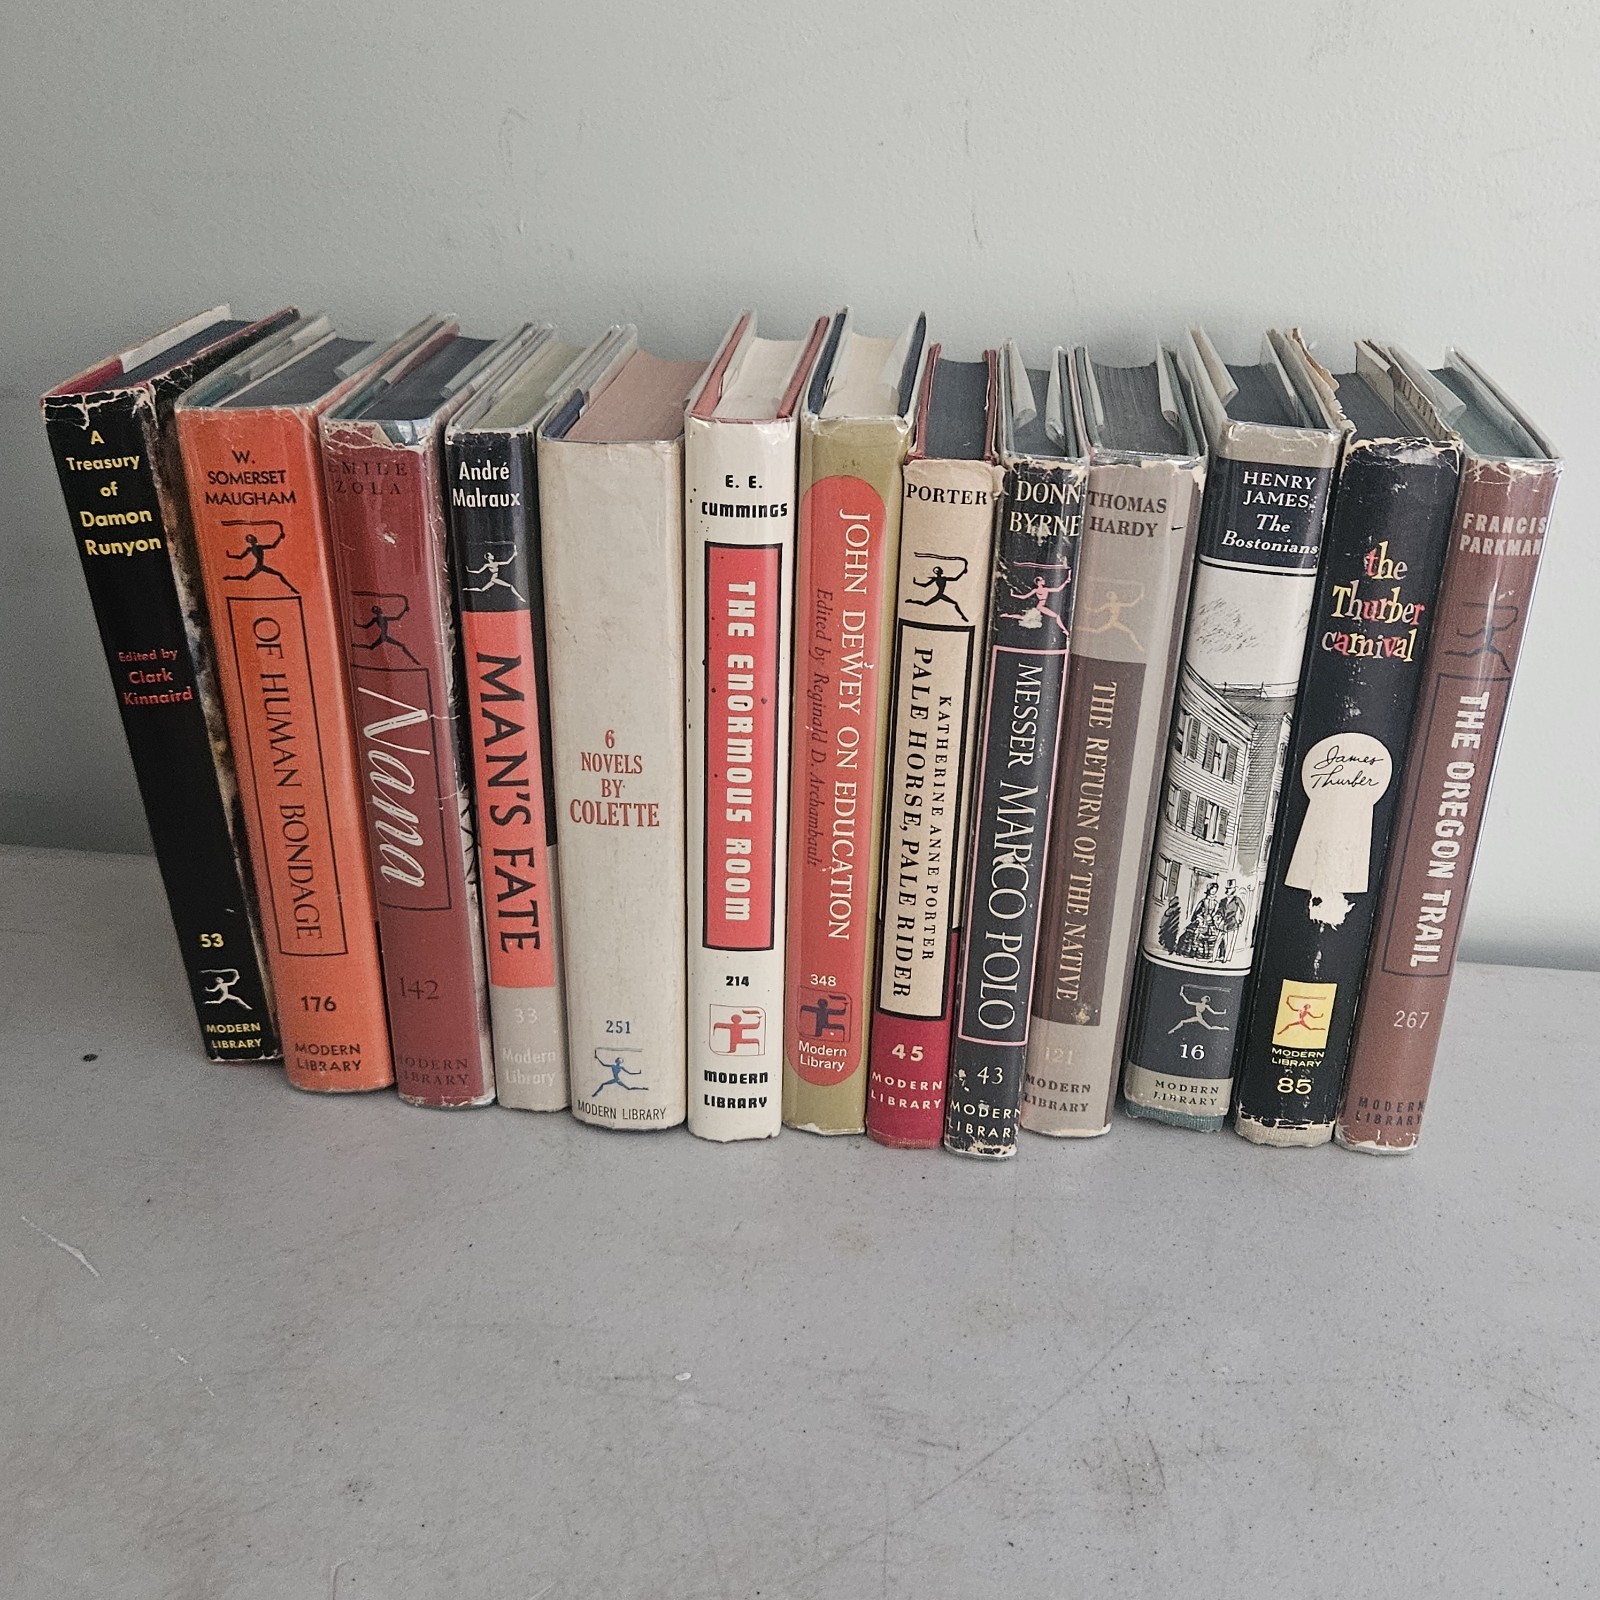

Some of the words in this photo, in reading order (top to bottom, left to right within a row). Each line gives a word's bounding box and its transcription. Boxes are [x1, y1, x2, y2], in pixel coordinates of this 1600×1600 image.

[90, 430, 104, 445] A
[66, 455, 140, 471] Treasury
[232, 450, 255, 464] W.
[207, 470, 286, 485] SOMERSET
[459, 459, 510, 480] André
[100, 481, 118, 497] of
[335, 480, 401, 495] ZOLA
[726, 475, 739, 488] E.
[749, 475, 763, 489] E.
[1243, 471, 1316, 490] HENRY
[205, 491, 296, 505] MAUGHAM
[452, 487, 521, 507] Malraux
[907, 483, 988, 505] PORTER
[1016, 480, 1080, 504] DONN
[1088, 491, 1167, 513] THOMAS
[80, 509, 152, 528] Damon
[702, 502, 788, 518] CUMMINGS
[1010, 511, 1081, 537] BYRNE
[1089, 516, 1158, 538] HARDY
[1256, 514, 1291, 533] The
[1463, 512, 1547, 534] FRANCIS
[84, 537, 161, 557] Runyon
[839, 508, 871, 594] JOHN
[1221, 531, 1319, 555] Bostonians
[1365, 541, 1408, 581] the
[728, 581, 756, 637] THE
[1331, 581, 1425, 626] Thurber
[815, 589, 833, 641] Edited
[253, 617, 284, 659] OF
[1321, 628, 1417, 662] carnival
[118, 650, 157, 662] Edited
[161, 649, 178, 661] by
[809, 649, 831, 665] by
[839, 610, 866, 715] DEWEY
[129, 668, 173, 684] Clark
[909, 647, 934, 720] PALE
[124, 687, 193, 705] Kinnaird
[1088, 681, 1118, 730] THE
[807, 671, 829, 744] Reginald
[1008, 662, 1043, 769] MESSER
[260, 672, 302, 788] HUMAN
[1451, 691, 1490, 749] THE
[476, 652, 532, 827] MAN'S
[605, 729, 615, 748] 6
[726, 654, 754, 823] ENORMOUS
[836, 726, 860, 770] ON
[581, 752, 643, 774] NOVELS
[811, 749, 827, 767] D.
[931, 695, 952, 816] KATHERINE
[1314, 745, 1384, 770] James
[357, 686, 430, 888] Nana
[899, 728, 927, 832] HORSE,
[1077, 738, 1110, 831] RETURN
[1310, 766, 1379, 789] Thurber
[601, 778, 623, 798] BY
[570, 799, 660, 827] COLETTE
[807, 771, 825, 867] Archambault
[1426, 760, 1476, 879] OREGON
[926, 824, 948, 879] ANNE
[989, 780, 1039, 920] MARCO
[1072, 835, 1097, 866] OF
[828, 781, 857, 940] EDUCATION
[280, 803, 323, 940] BONDAGE
[725, 838, 752, 921] ROOM
[898, 838, 921, 908] PALE
[493, 847, 540, 954] FATE
[1066, 872, 1092, 916] THE
[921, 885, 943, 960] PORTER
[1410, 889, 1453, 968] TRAIL
[201, 933, 224, 948] 53
[893, 912, 916, 997] RIDER
[1056, 921, 1086, 1001] NATIVE
[401, 977, 439, 1000] 142
[726, 976, 749, 987] 214
[810, 974, 837, 987] 348
[978, 931, 1023, 1030] POLO
[301, 996, 337, 1012] 176
[514, 1008, 538, 1023] 33
[1394, 1010, 1429, 1029] 267
[206, 1022, 261, 1033] MODERN
[606, 1020, 631, 1034] 251
[212, 1038, 262, 1050] LIBRARY
[295, 1043, 361, 1056] MODERN
[799, 1040, 847, 1057] Modern
[892, 1044, 924, 1061] 45
[1180, 1044, 1205, 1060] 16
[1272, 1047, 1325, 1058] MODERN
[296, 1059, 361, 1072] LIBRARY
[400, 1056, 468, 1070] ODERN
[502, 1048, 556, 1064] Modern
[800, 1056, 845, 1072] Library
[1045, 1047, 1073, 1066] 121
[1272, 1058, 1322, 1067] LIBRARY
[506, 1069, 556, 1087] Library
[704, 1070, 768, 1084] MODERN
[872, 1071, 942, 1091] MODERN
[977, 1066, 1003, 1085] 43
[1026, 1073, 1091, 1093] MODERN
[1155, 1079, 1219, 1094] MODERN
[1277, 1077, 1313, 1095] 85
[704, 1094, 768, 1109] LIBRARY
[871, 1089, 942, 1109] LIBRARY
[1023, 1092, 1089, 1112] LIBRARY
[1153, 1091, 1218, 1106] LIBRARY
[577, 1100, 617, 1119] MODERN
[622, 1108, 667, 1121] LIBRARY
